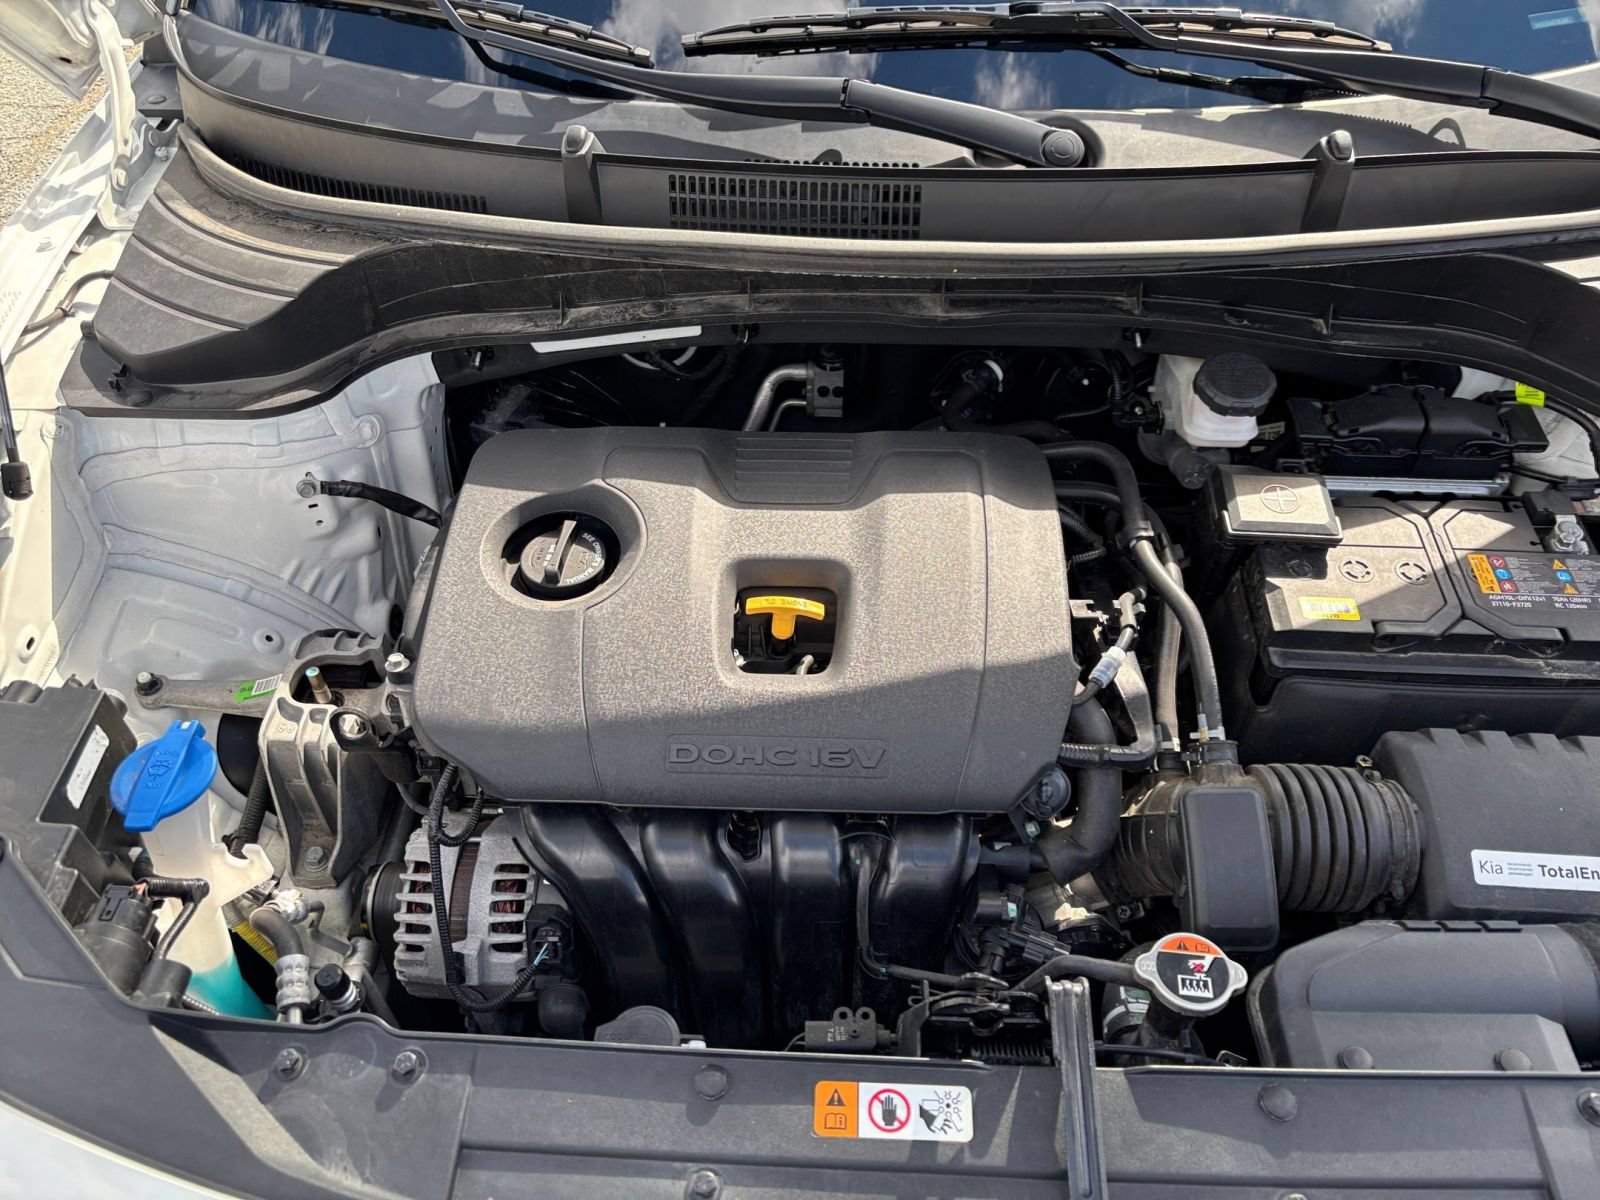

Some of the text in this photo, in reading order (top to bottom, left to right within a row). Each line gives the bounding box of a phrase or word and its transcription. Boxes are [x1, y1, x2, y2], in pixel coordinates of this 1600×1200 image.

[582, 532, 596, 543] SEE
[565, 567, 595, 584] MANUAL
[668, 743, 887, 769] DOHC 16V
[1479, 859, 1504, 875] Kia
[1537, 864, 1600, 880] TotalEn
